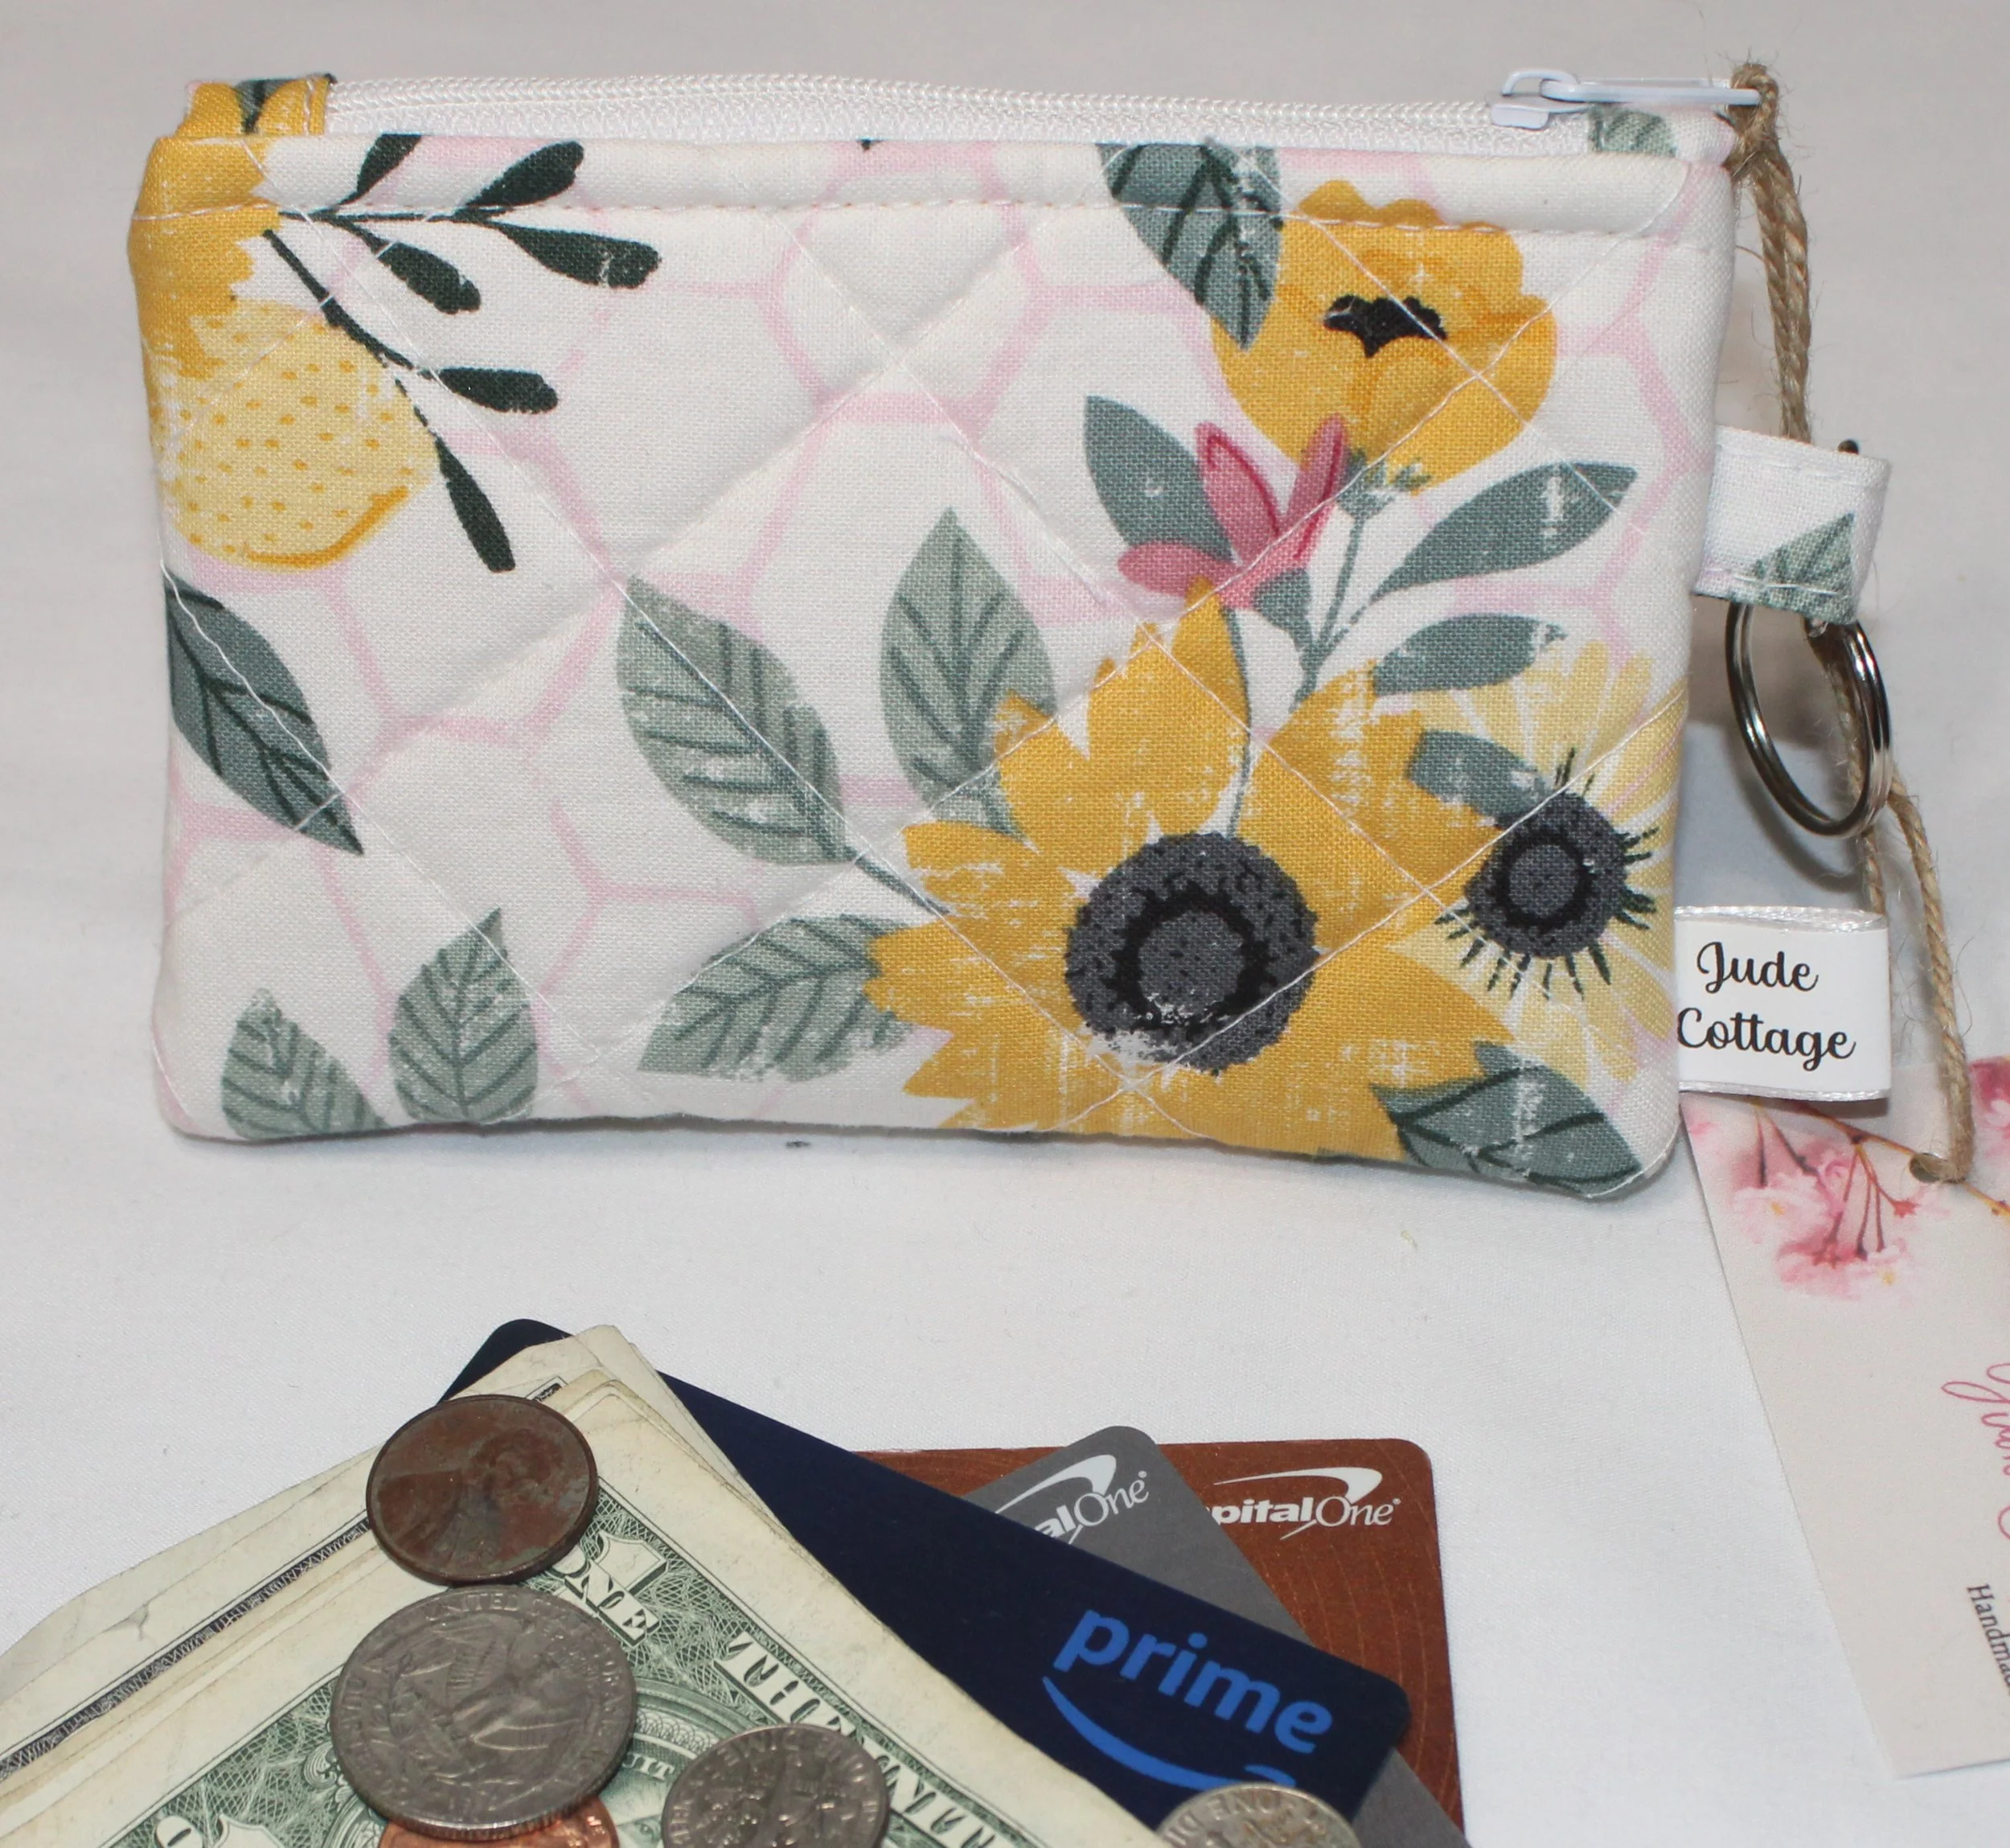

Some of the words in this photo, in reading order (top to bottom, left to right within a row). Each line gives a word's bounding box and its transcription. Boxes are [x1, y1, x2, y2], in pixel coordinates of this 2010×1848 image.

[1697, 942, 1819, 994] Jude
[1677, 1008, 1857, 1071] Cottage
[1052, 1610, 1332, 1754] prime
